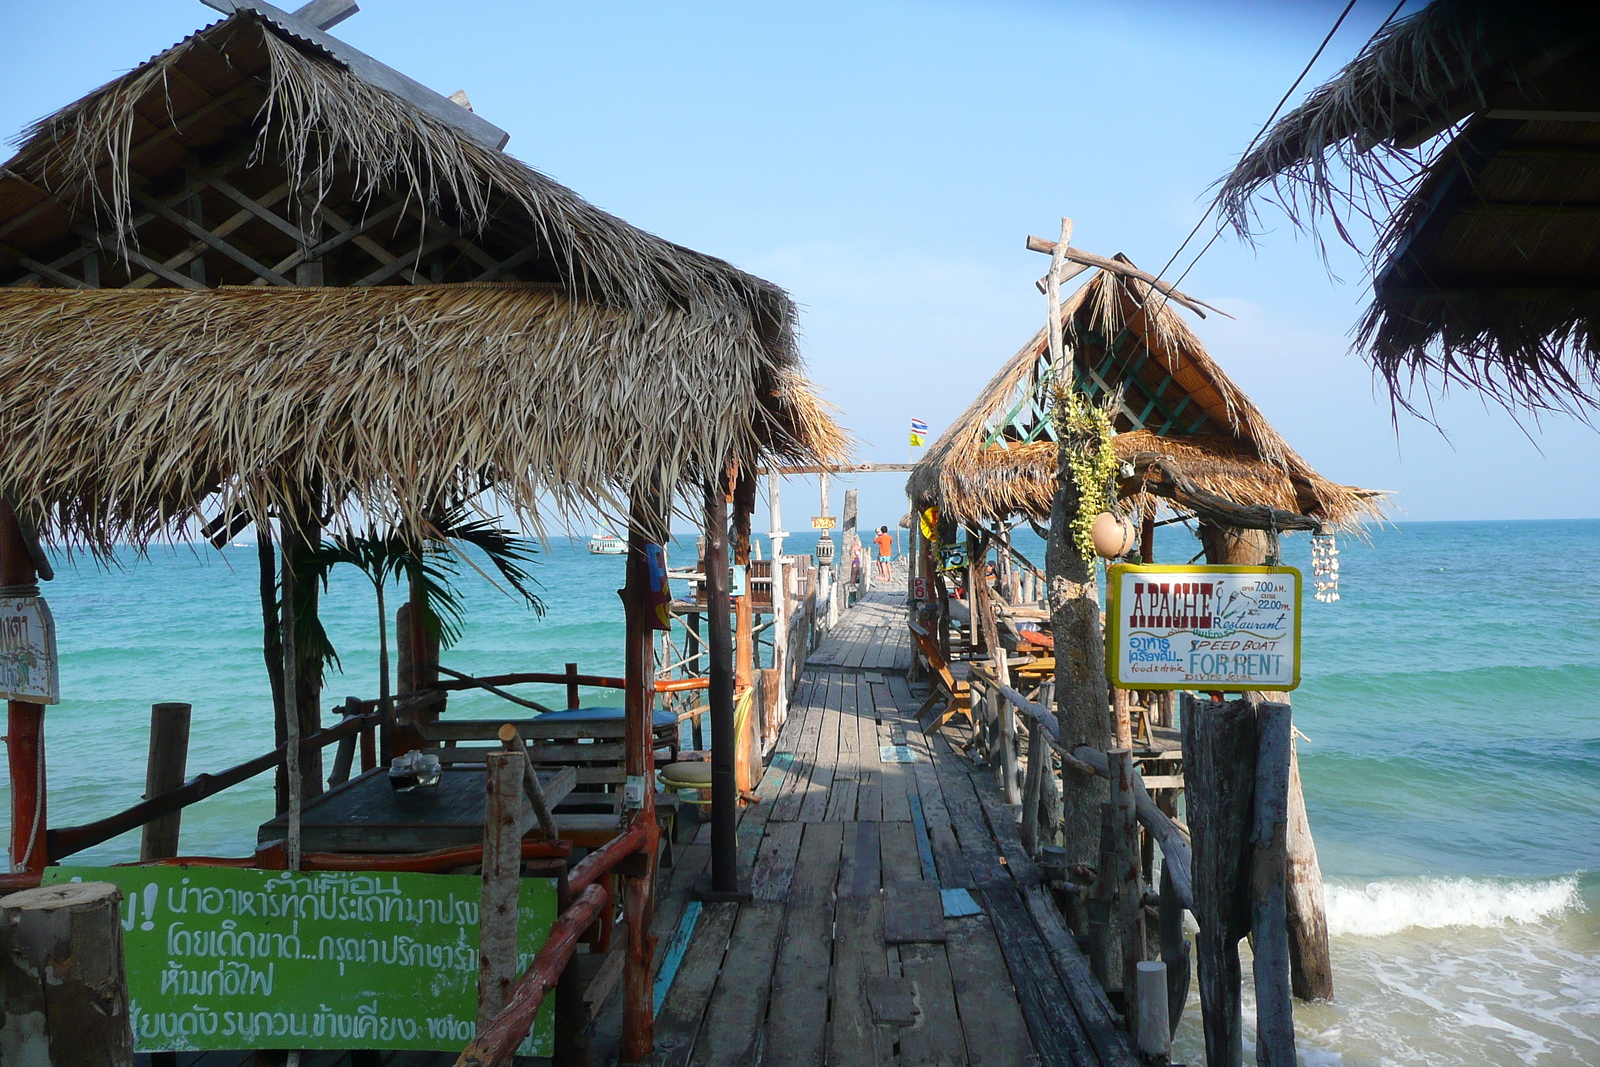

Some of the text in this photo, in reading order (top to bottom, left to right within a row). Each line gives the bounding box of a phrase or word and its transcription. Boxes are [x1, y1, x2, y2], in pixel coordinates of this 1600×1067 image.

[1254, 581, 1273, 592] 7.00
[1129, 582, 1214, 629] APACHE
[1258, 599, 1281, 610] 22.00
[1213, 611, 1287, 630] Restaurant
[1188, 639, 1281, 653] SPEED BOAT
[1189, 653, 1284, 676] FOR RENT
